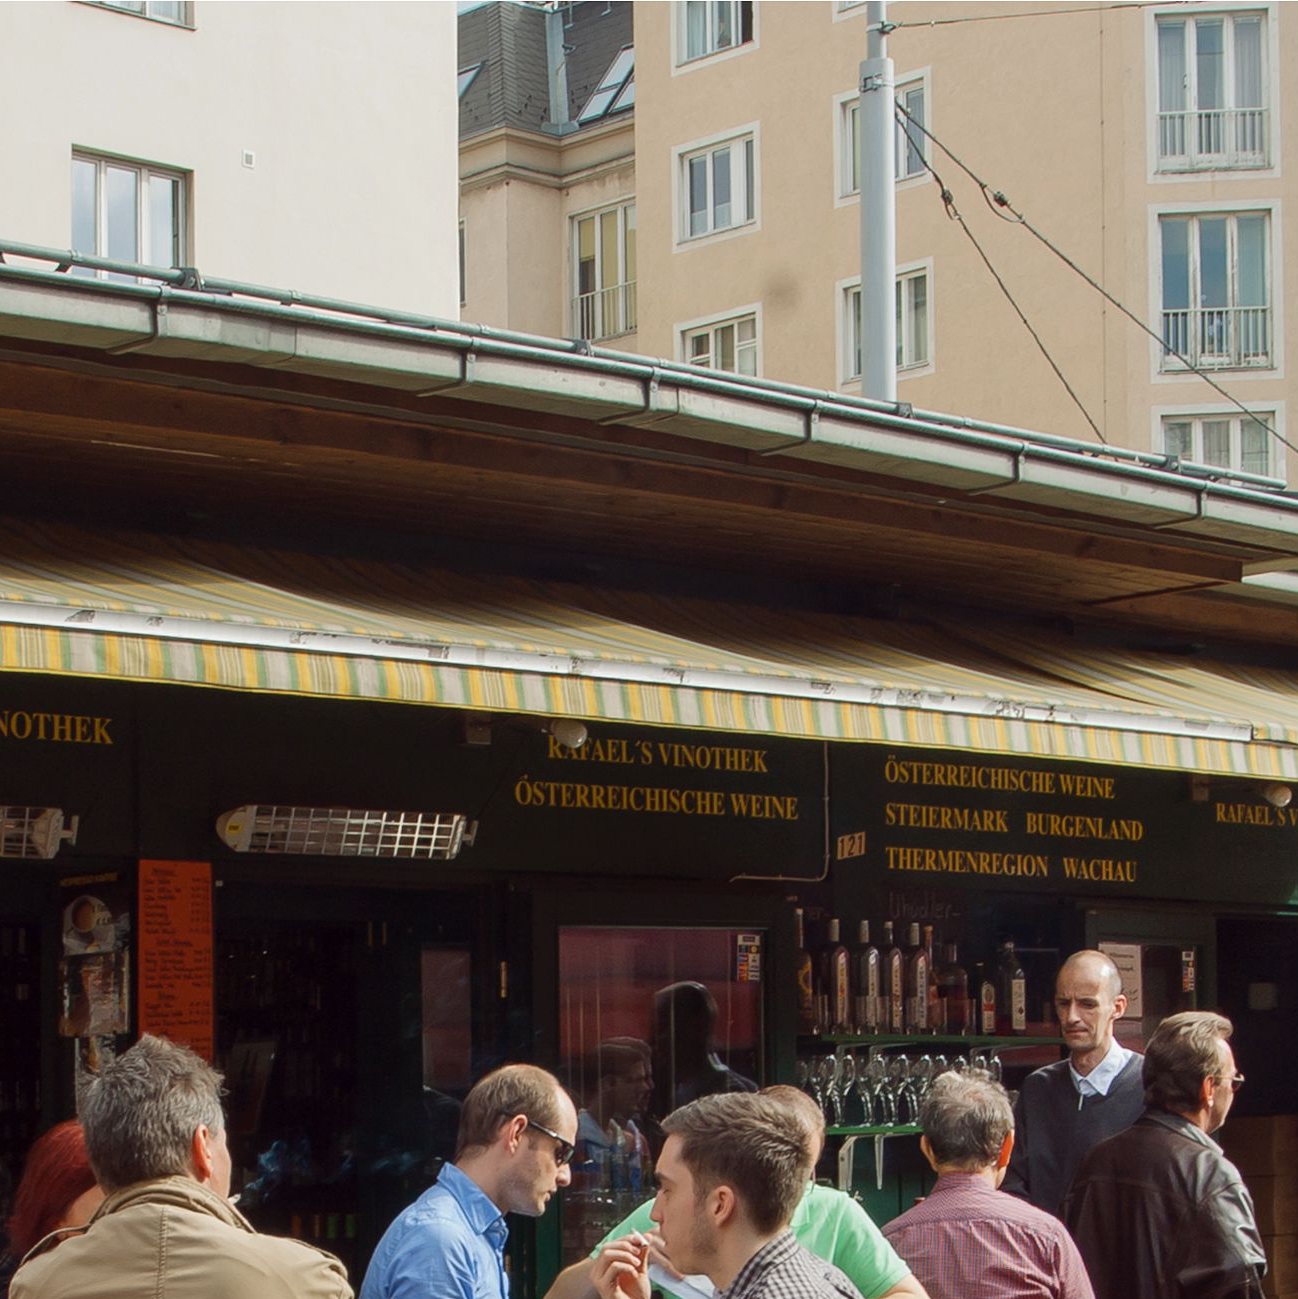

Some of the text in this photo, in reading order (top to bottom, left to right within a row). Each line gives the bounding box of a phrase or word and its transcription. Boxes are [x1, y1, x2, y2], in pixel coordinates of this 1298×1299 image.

[657, 742, 769, 774] VINOTHEK
[884, 755, 1117, 801] ÖSTERREICHISCHE WEINE
[729, 793, 799, 821] WEINE
[885, 803, 1145, 842] STEIERMARK BURGENLAND
[840, 835, 863, 858] 121
[885, 847, 1138, 883] THERMENREGION WACHAU
